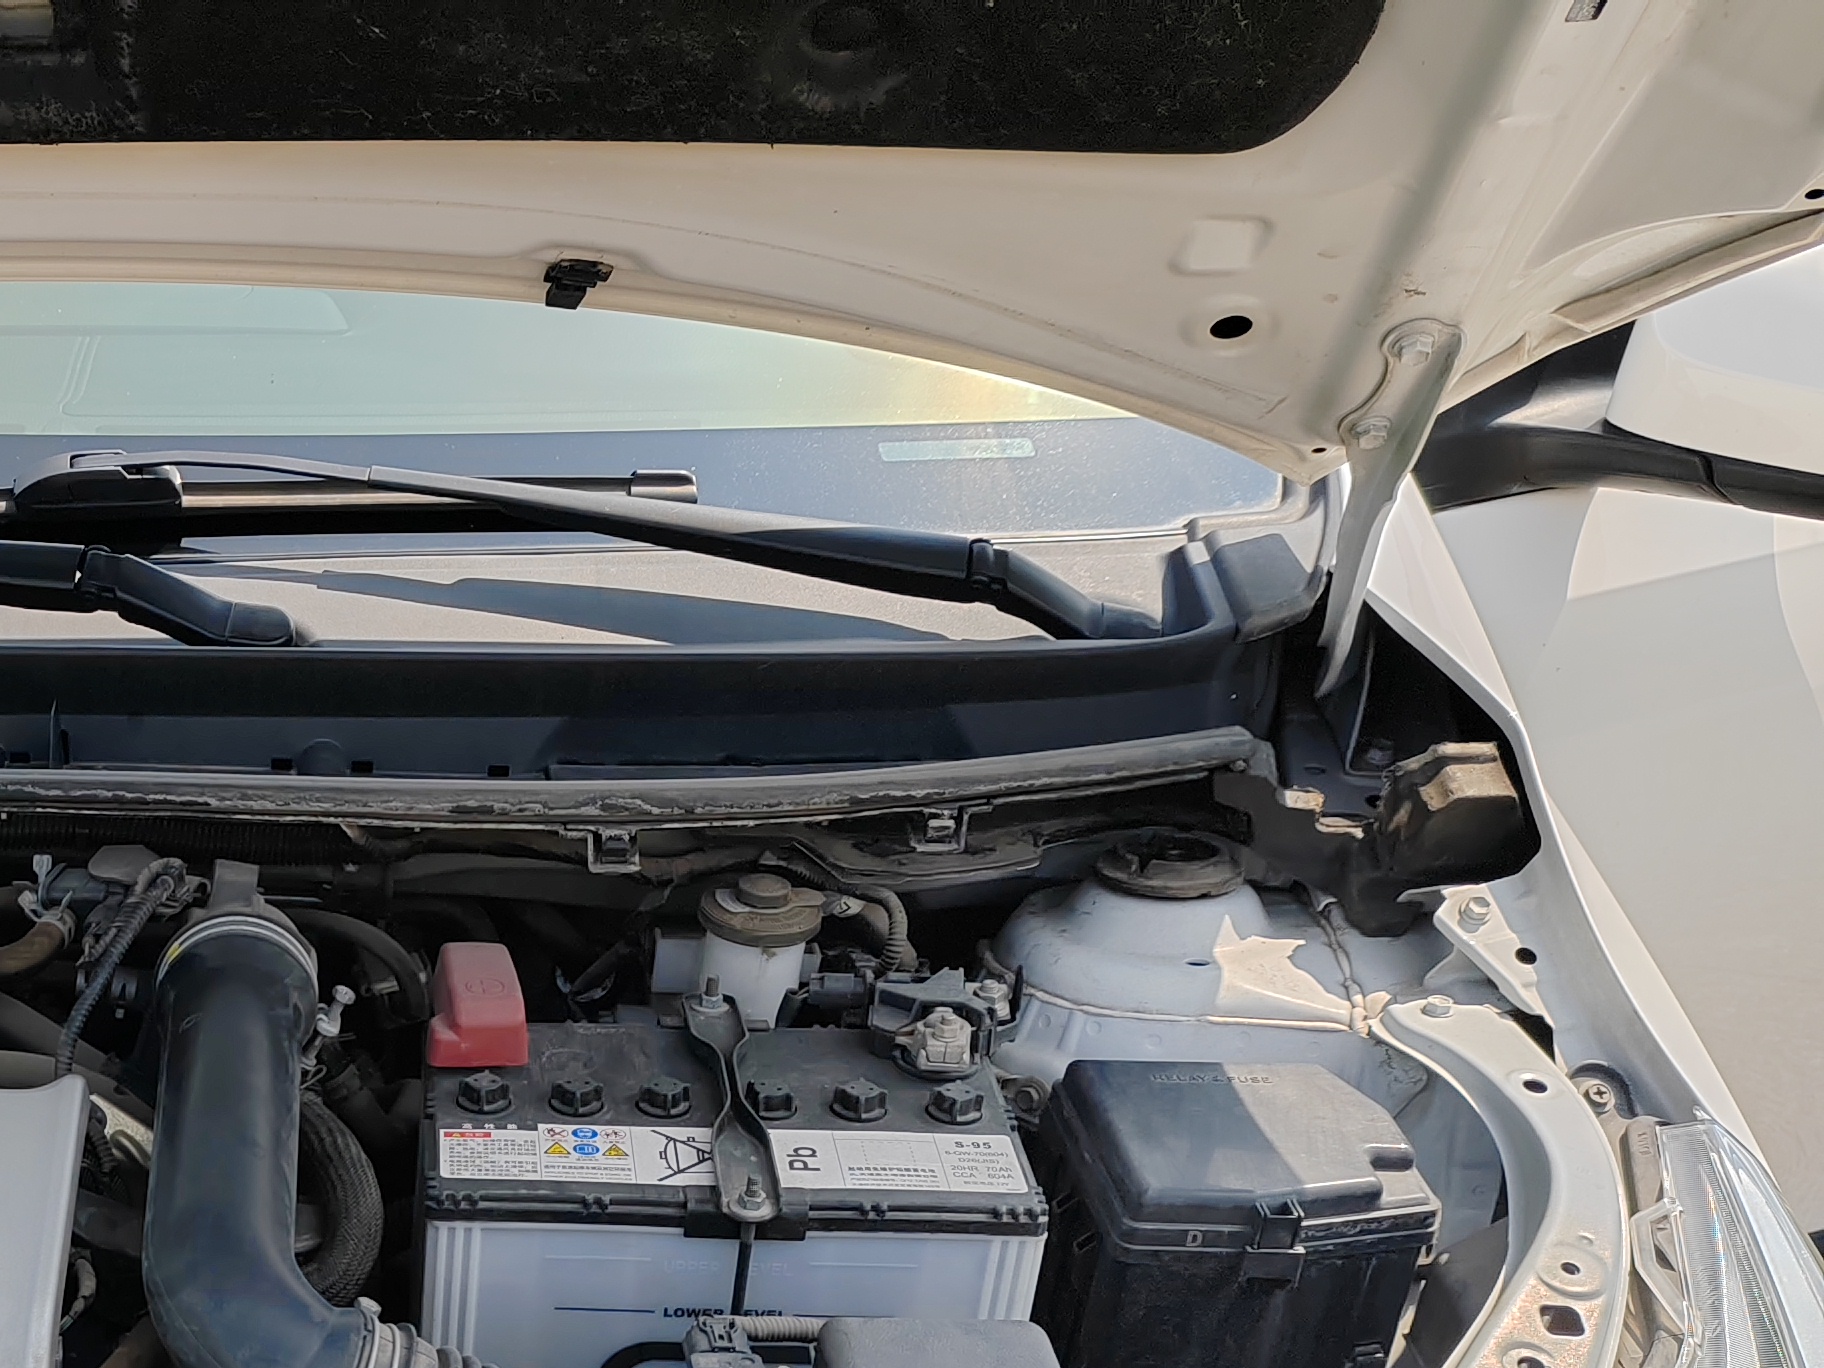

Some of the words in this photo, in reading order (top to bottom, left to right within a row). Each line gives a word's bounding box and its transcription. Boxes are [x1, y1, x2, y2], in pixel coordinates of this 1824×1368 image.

[1227, 1075, 1273, 1084] FUSE
[785, 1146, 821, 1172] Pb
[952, 1171, 977, 1179] CCA
